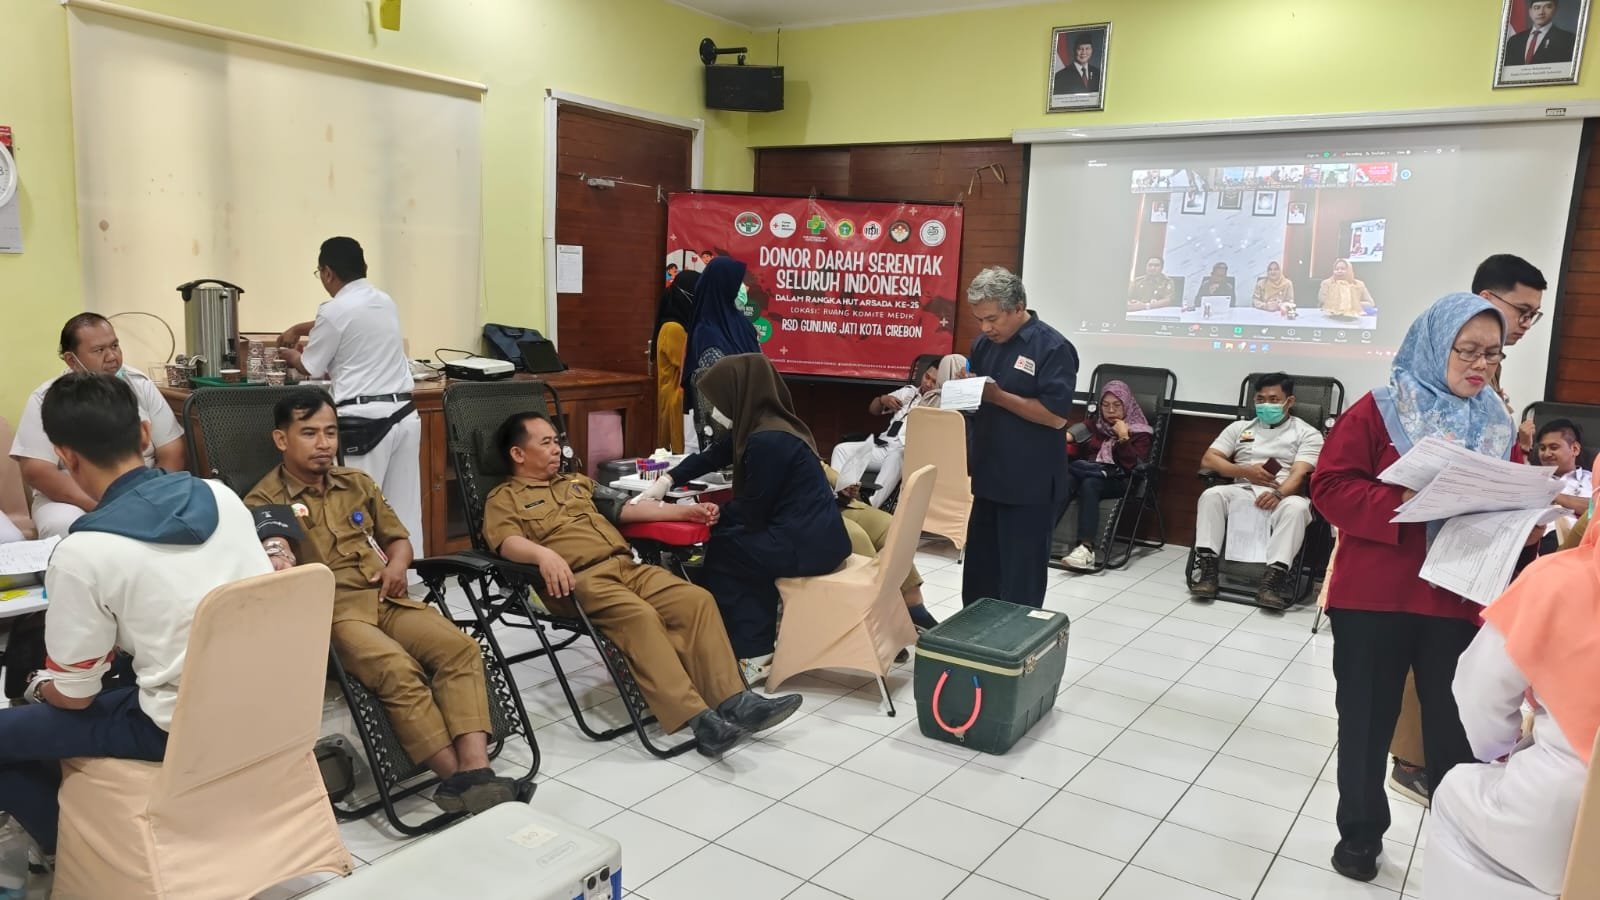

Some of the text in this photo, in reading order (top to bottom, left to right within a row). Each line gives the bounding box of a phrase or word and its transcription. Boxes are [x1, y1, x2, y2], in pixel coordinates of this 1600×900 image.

[760, 246, 943, 276] DONOR DARAH SERENTAK
[776, 269, 921, 296] SELURUH INDONESIA
[775, 294, 920, 309] DALAM RANGKA HUT ARSADA KE-25
[823, 308, 850, 316] RUANG
[852, 310, 884, 318] KOMITE
[781, 318, 798, 331] RSD
[800, 320, 837, 333] GUNUNG
[839, 322, 857, 335] JATI
[859, 323, 882, 336] KOTA
[885, 324, 923, 338] CIREBON
